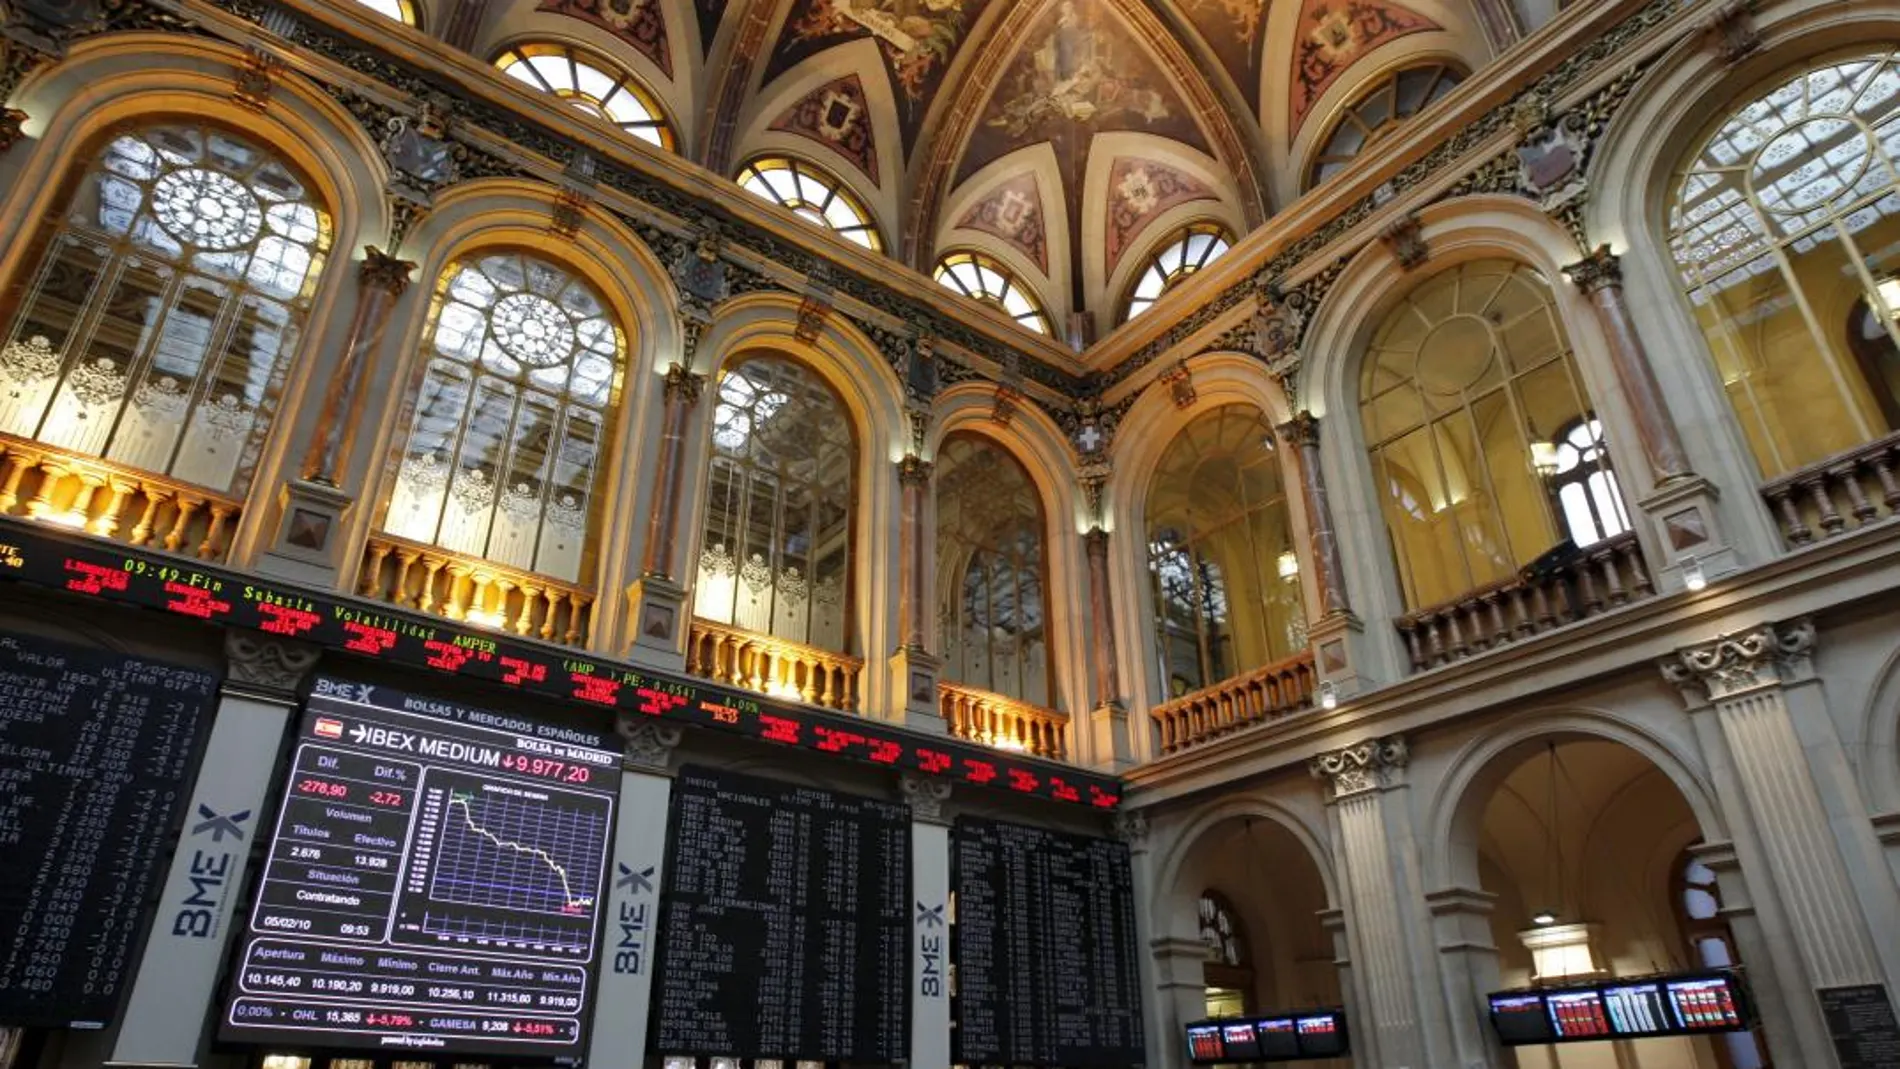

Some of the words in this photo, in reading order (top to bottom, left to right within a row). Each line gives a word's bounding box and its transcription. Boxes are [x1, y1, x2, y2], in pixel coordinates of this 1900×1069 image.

[244, 586, 313, 612] Subasta
[334, 606, 436, 639] Volatilidad
[453, 635, 496, 653] AMPER
[404, 698, 452, 716] BOLSAS
[456, 709, 466, 719] Y
[468, 711, 533, 732] MERCADOS
[537, 725, 599, 746] ESPAÑOLES
[318, 756, 339, 769] Dif.
[366, 727, 417, 751] IBEX
[418, 738, 500, 767] MEDIUM
[516, 756, 589, 782] 9.977,20
[516, 738, 552, 754] BOLSA
[567, 747, 613, 765] MADRID
[298, 780, 347, 797] -278,90
[326, 808, 372, 823] Volumen
[354, 834, 397, 848] Efectivo
[173, 850, 229, 937] BME
[296, 890, 360, 906] Contratando
[264, 916, 311, 930] 05/02/10
[341, 924, 369, 936] 09:53
[614, 901, 644, 974] BME
[254, 946, 305, 962] Apertura
[428, 962, 458, 974] Cierre
[922, 934, 939, 997] BME
[293, 1010, 319, 1021] OHL
[430, 1018, 476, 1030] GAMESA
